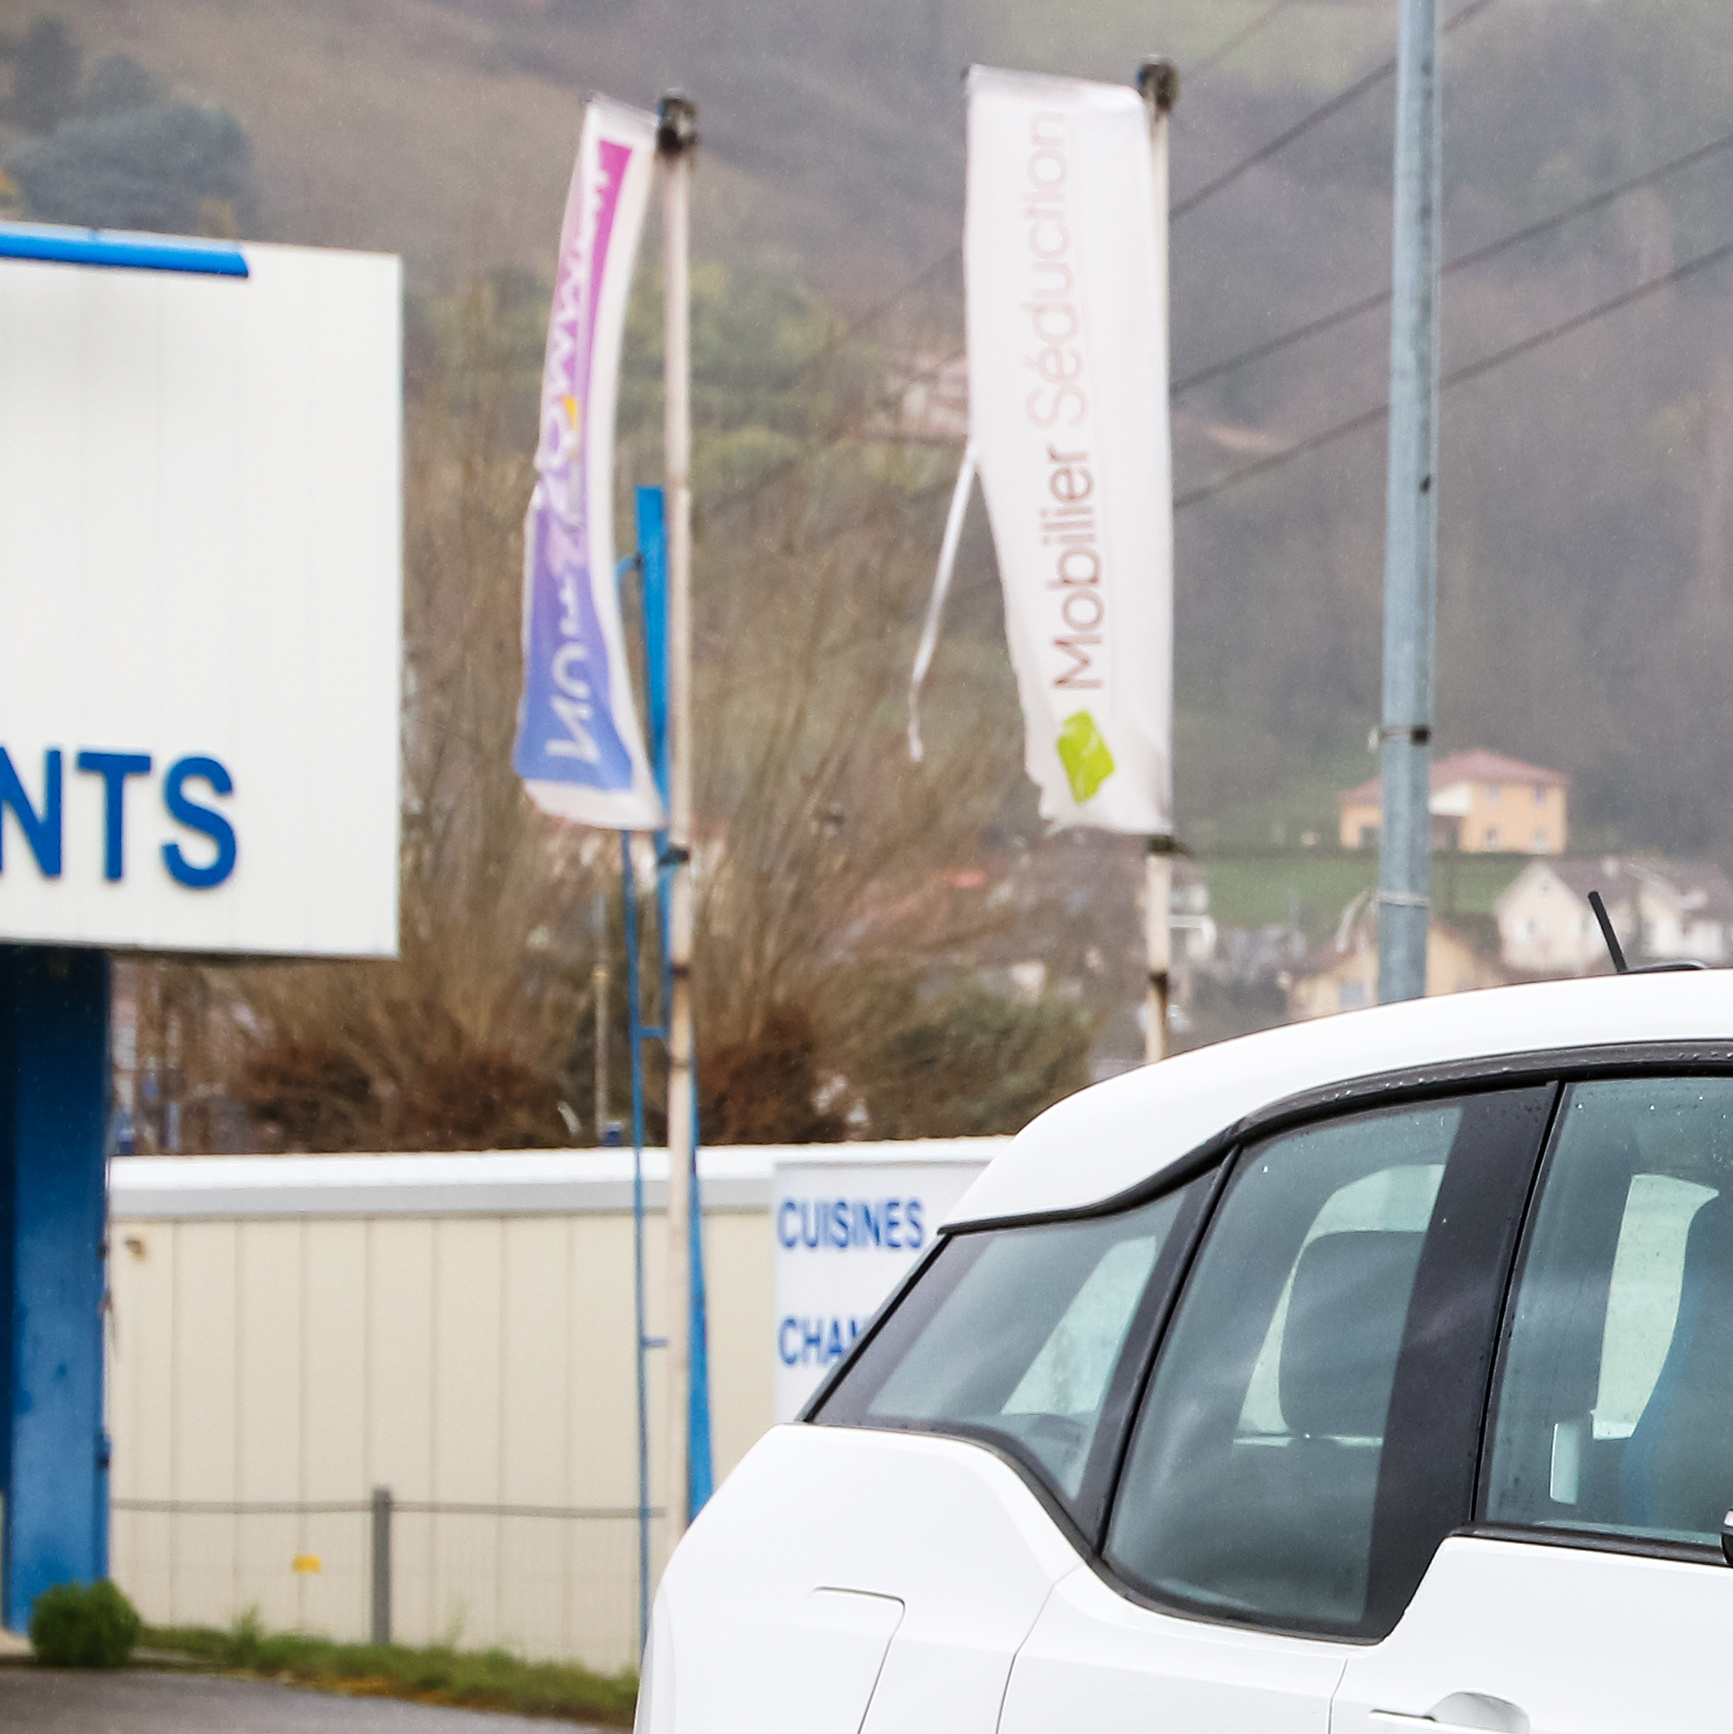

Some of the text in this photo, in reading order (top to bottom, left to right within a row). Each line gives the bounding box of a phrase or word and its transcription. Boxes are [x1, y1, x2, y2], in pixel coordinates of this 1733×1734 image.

[1021, 111, 1104, 690] Mobilier Séduction
[777, 1198, 924, 1250] CUISINES
